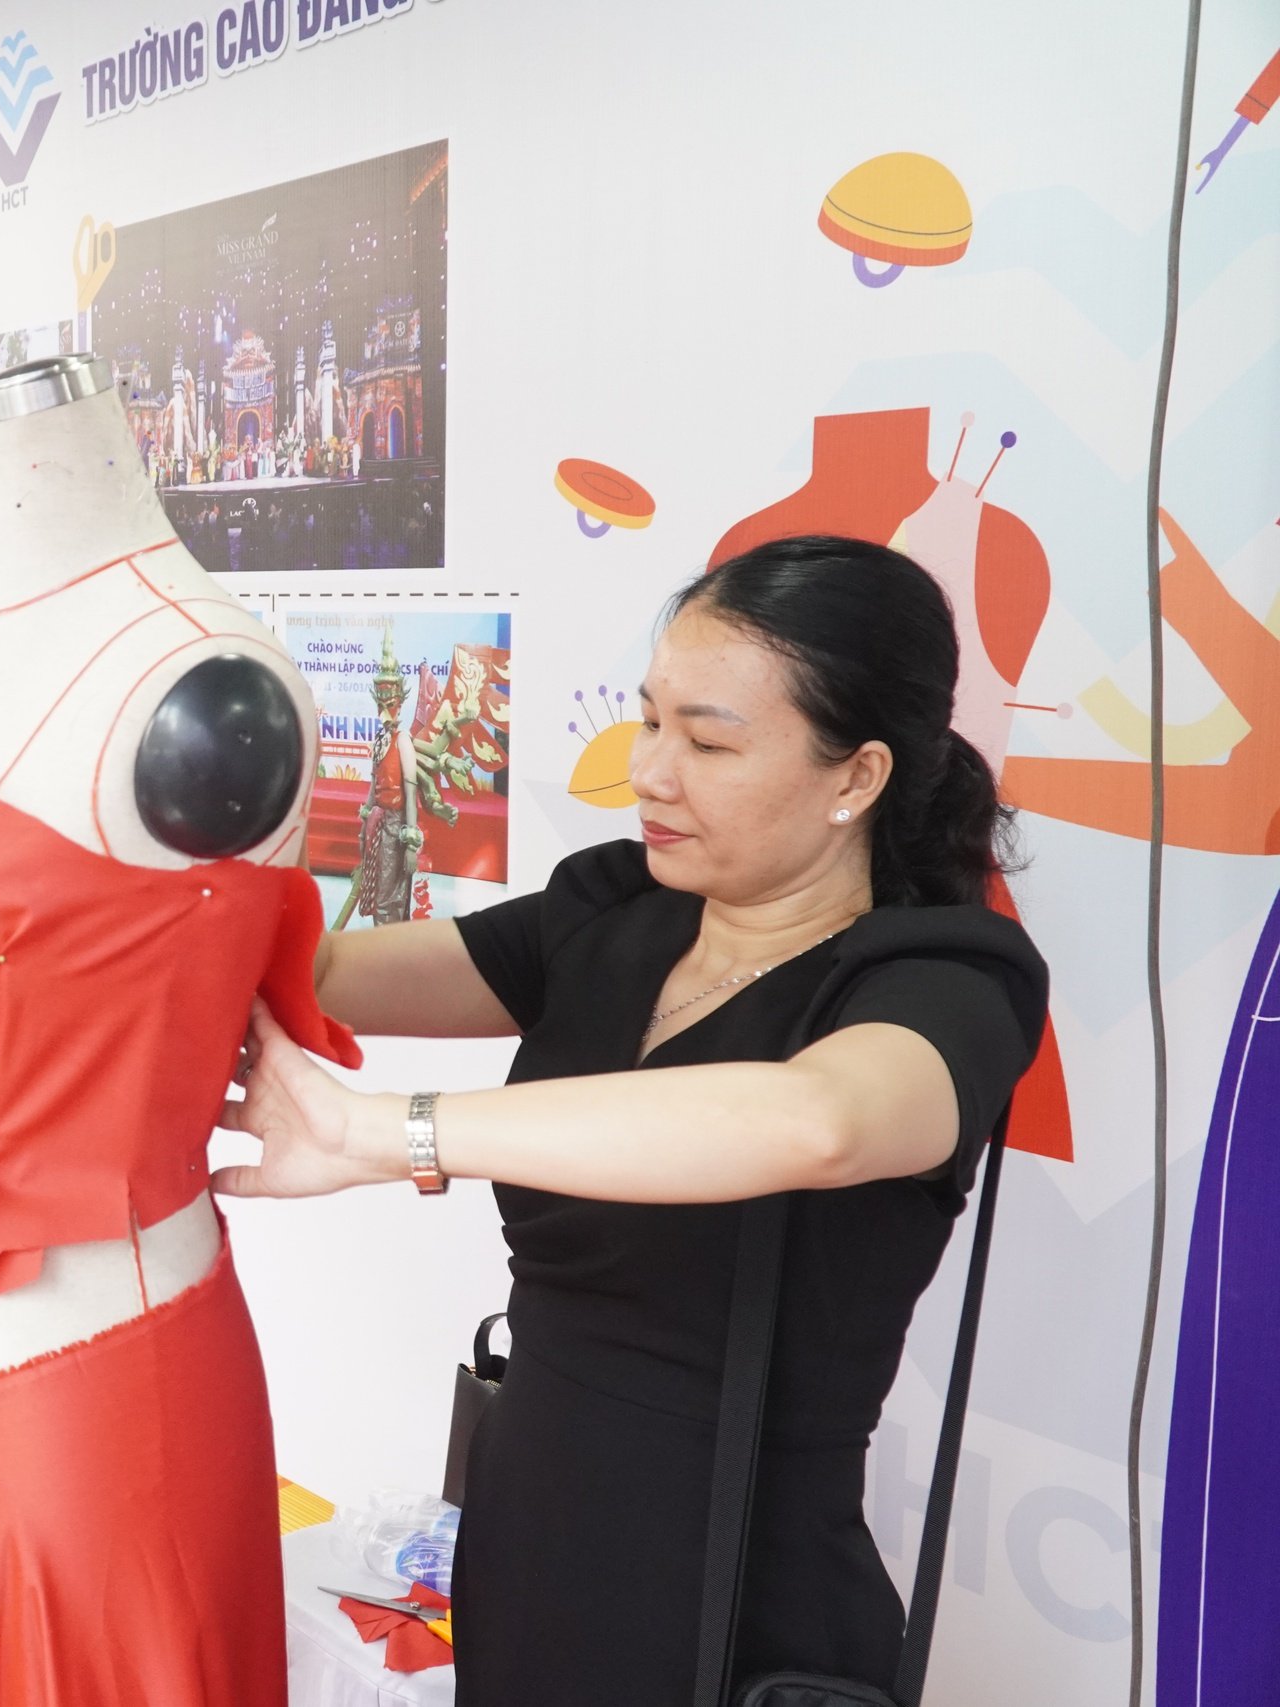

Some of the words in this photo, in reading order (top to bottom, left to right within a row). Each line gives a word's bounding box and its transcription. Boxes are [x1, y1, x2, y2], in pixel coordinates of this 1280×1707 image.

[82, 21, 205, 118] TRƯỜNG
[216, 0, 285, 70] CAO
[1, 185, 29, 212] HCT
[216, 240, 240, 257] MISS
[240, 231, 279, 250] GRAND
[307, 638, 333, 653] CHÀO
[334, 639, 364, 654] MỪNG
[304, 657, 336, 672] THÀNH
[338, 658, 355, 677] LẬP
[431, 660, 450, 676] CHÍ
[873, 1417, 1161, 1643] HC
